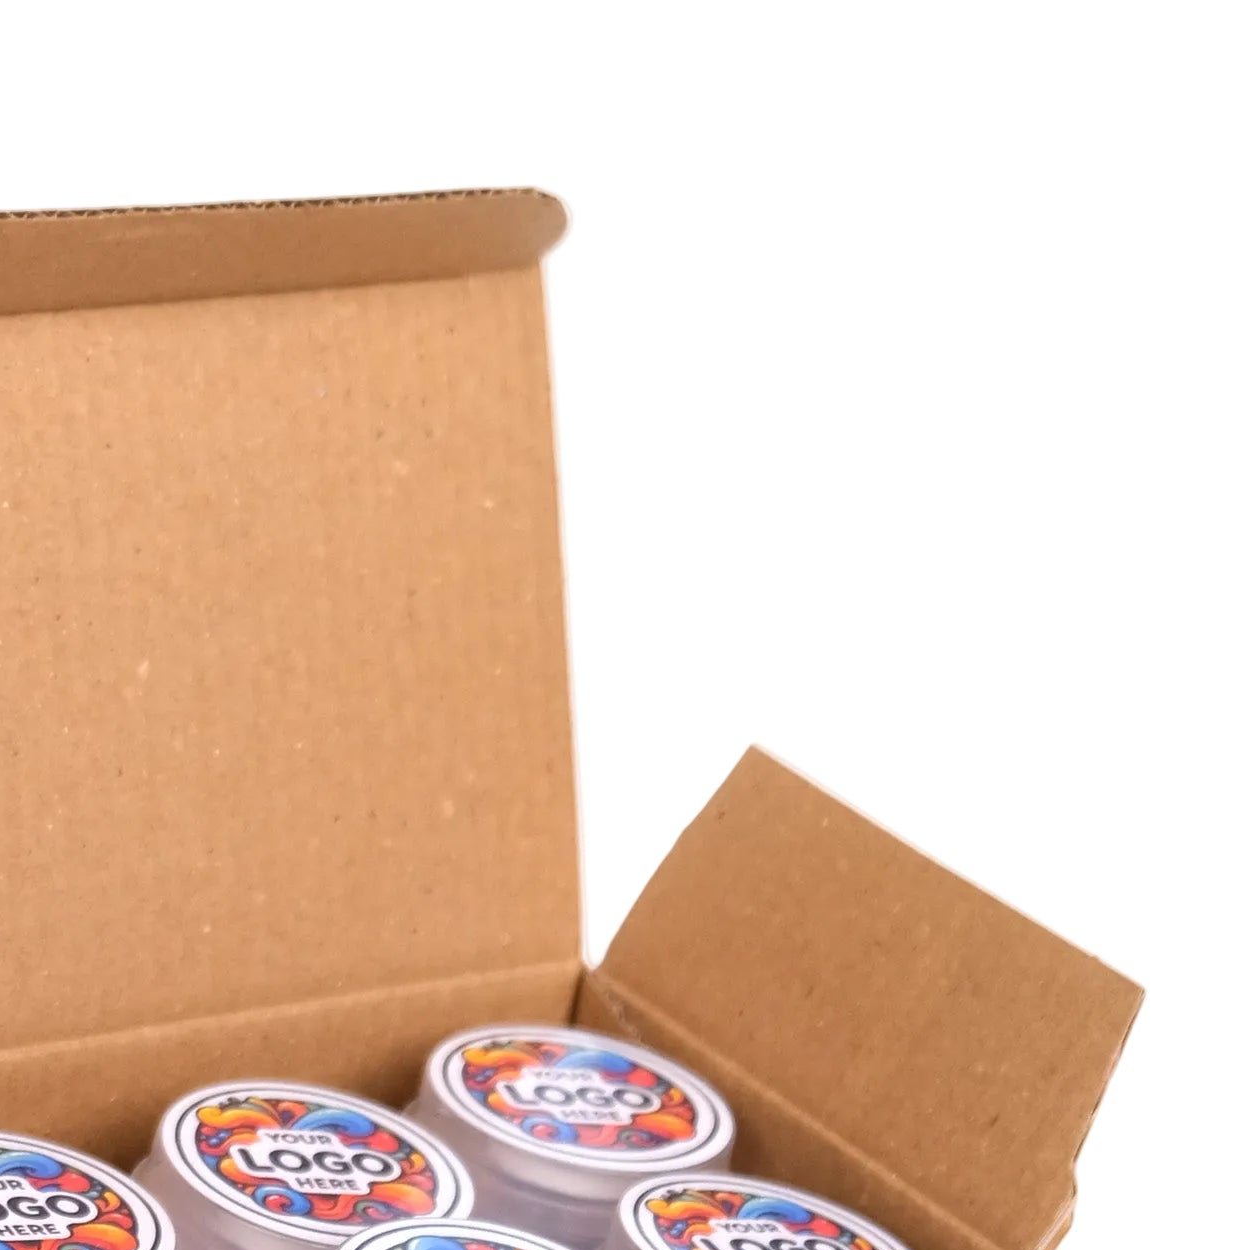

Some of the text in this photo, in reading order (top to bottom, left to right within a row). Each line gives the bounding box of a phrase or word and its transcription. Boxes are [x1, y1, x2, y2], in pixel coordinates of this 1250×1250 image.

[504, 1083, 650, 1106] LOGO
[264, 1132, 334, 1145] YOUR
[237, 1148, 393, 1174] LOGO
[295, 1177, 360, 1190] HERE
[717, 1222, 781, 1233] YOUR
